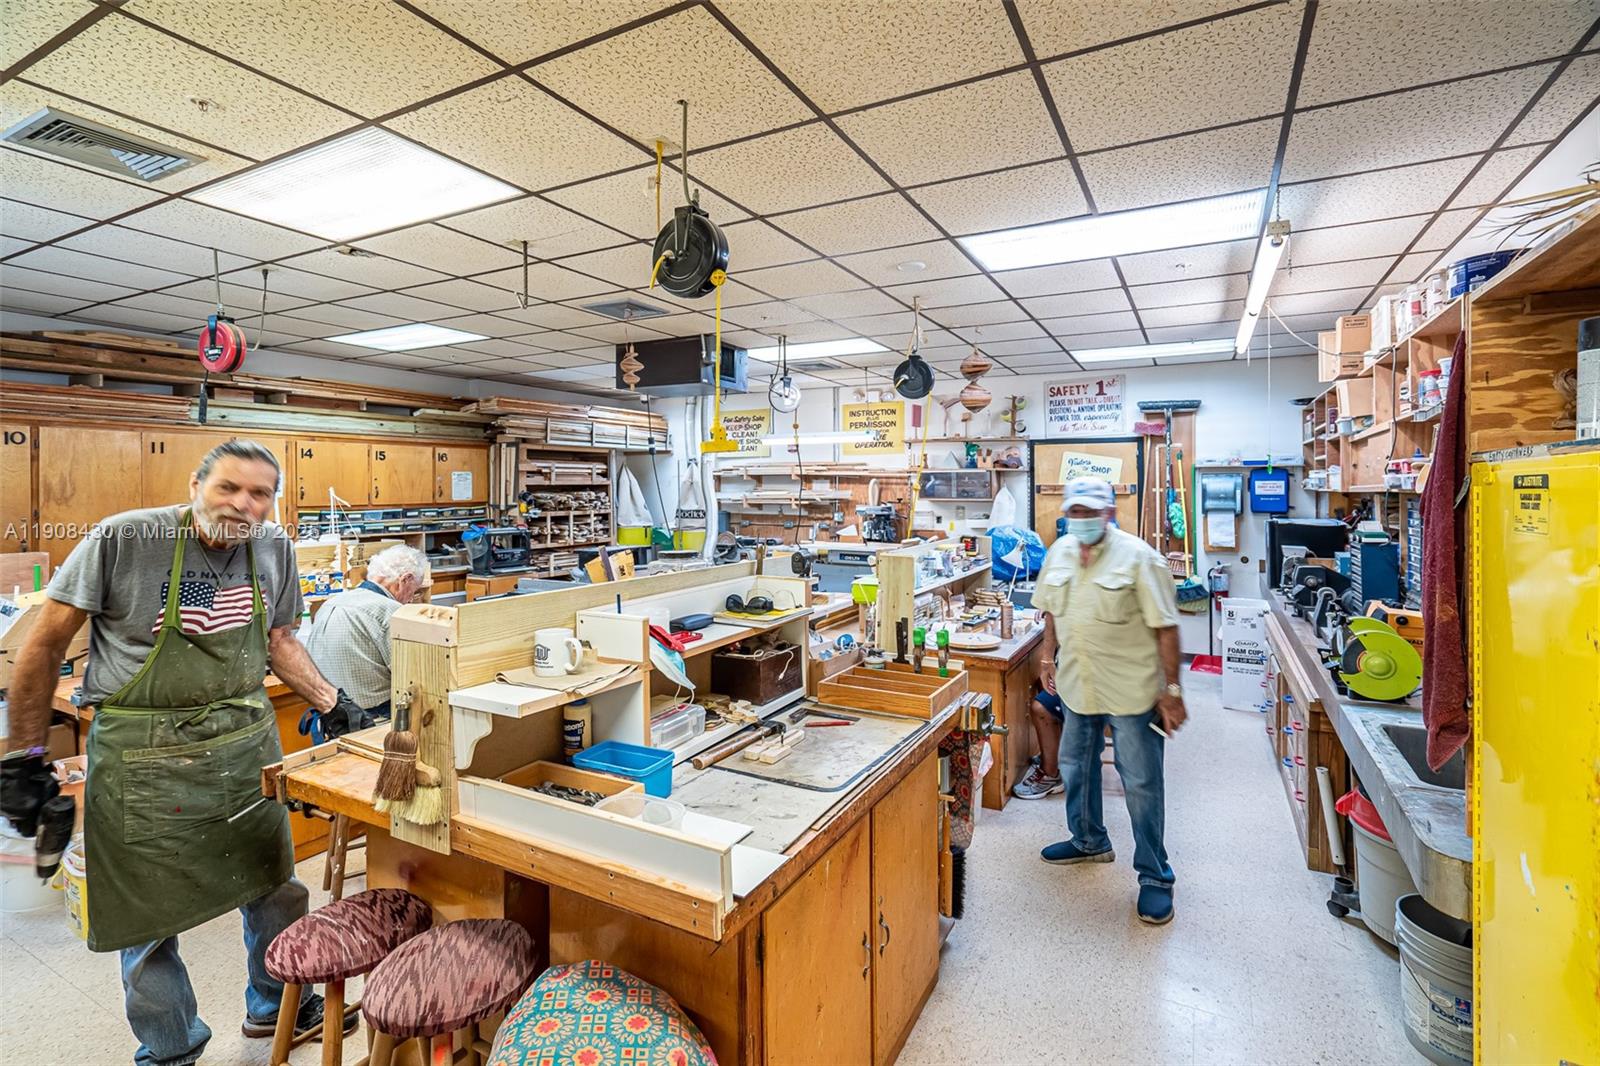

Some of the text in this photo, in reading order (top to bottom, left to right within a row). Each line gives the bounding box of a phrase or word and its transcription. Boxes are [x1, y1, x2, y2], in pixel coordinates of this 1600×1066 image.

[1049, 384, 1089, 397] SAFETY
[1049, 399, 1066, 407] PLEASE
[849, 409, 897, 417] INSTRUCTION
[734, 416, 751, 424] Safety
[849, 420, 897, 429] PERMISSION
[744, 423, 762, 431] SHOP
[4, 431, 26, 445] 10
[151, 441, 164, 454] 11
[300, 448, 313, 459] 14
[375, 450, 386, 461] 15
[437, 452, 448, 462] 16
[1091, 465, 1112, 474] SHOP
[1227, 647, 1246, 655] FOAM
